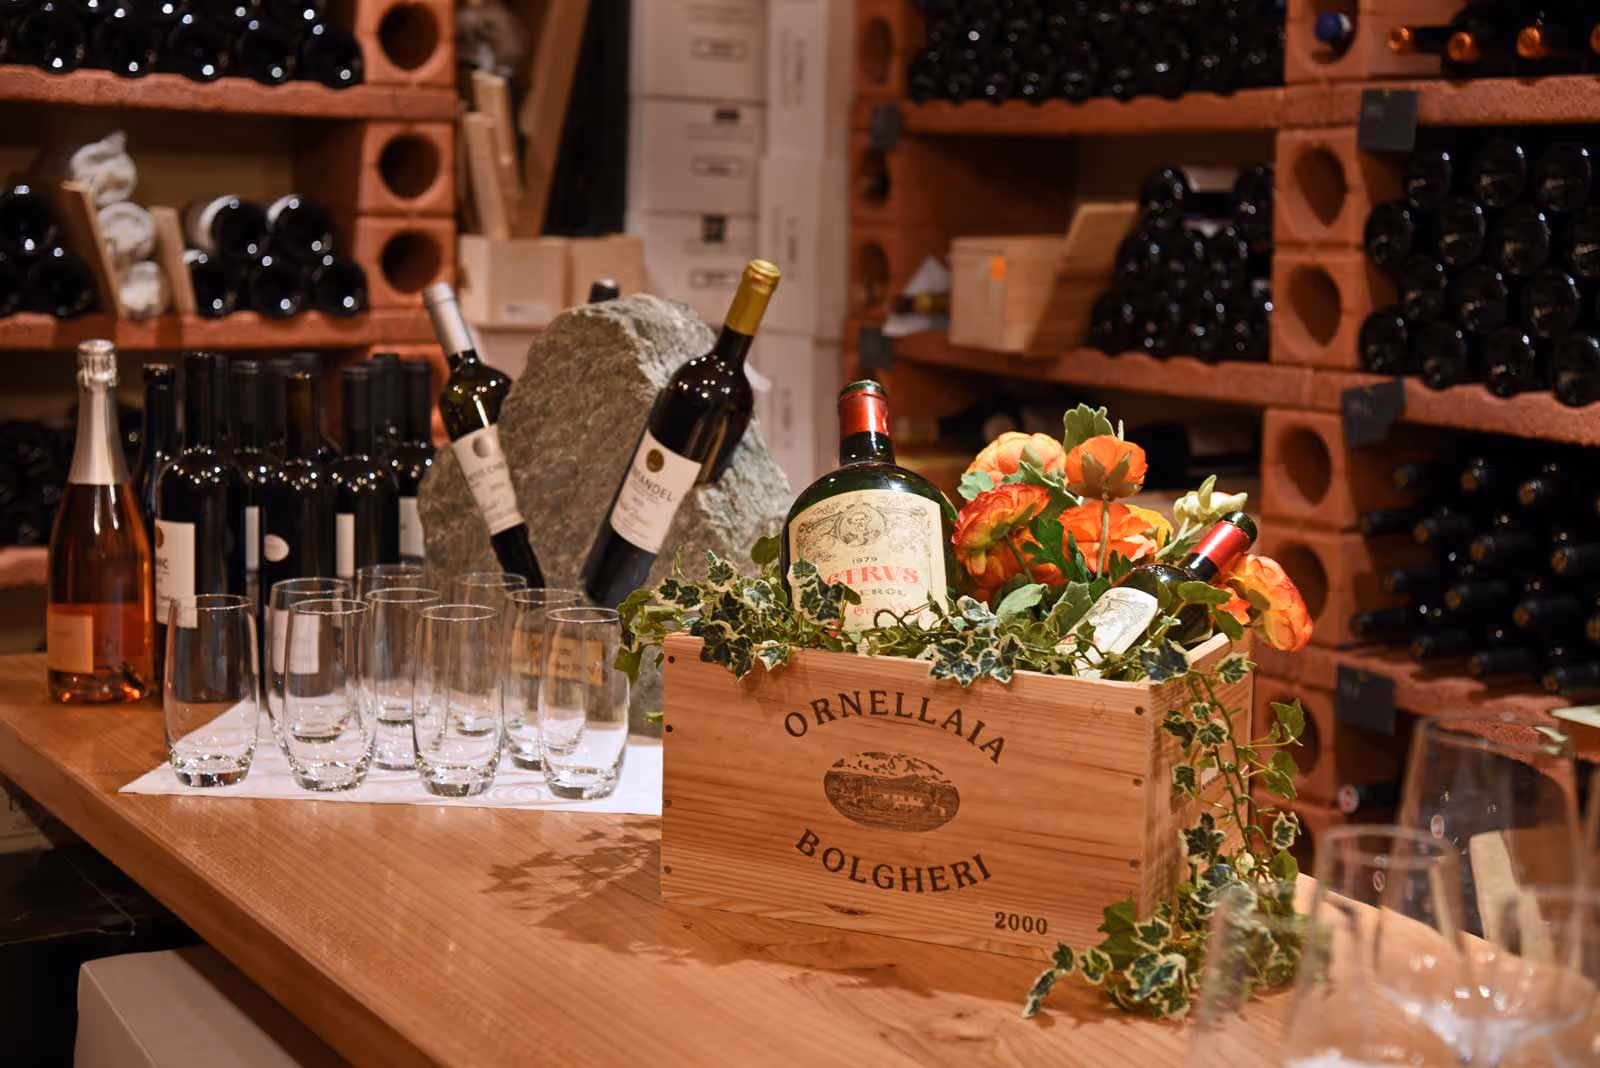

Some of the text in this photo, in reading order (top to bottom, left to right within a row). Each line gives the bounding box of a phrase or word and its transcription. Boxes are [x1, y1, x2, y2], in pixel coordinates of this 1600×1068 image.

[852, 556, 878, 565] 1979
[825, 565, 919, 586] ETRVS
[784, 688, 1006, 764] ORNELLAIA
[794, 829, 992, 893] BOLGHERI
[994, 911, 1048, 935] 2000
